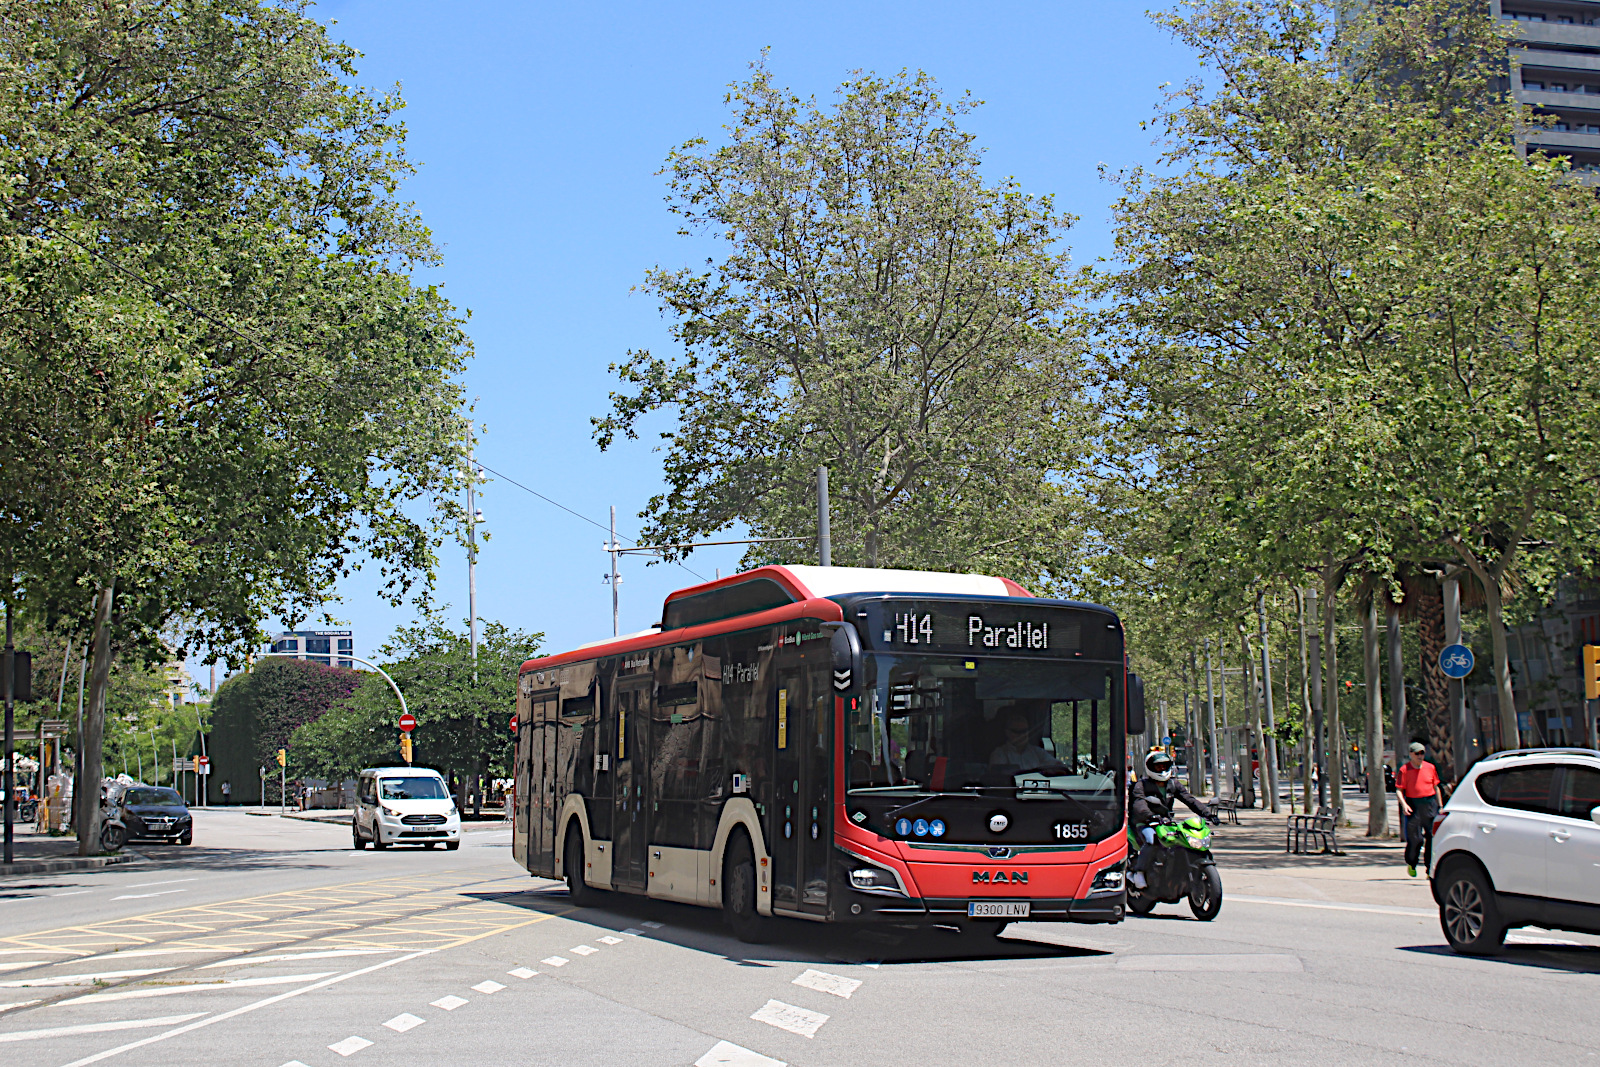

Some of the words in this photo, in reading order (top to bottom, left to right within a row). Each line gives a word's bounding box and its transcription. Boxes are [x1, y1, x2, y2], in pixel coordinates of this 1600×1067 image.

[895, 612, 933, 644] H14
[723, 664, 734, 685] H14
[1054, 823, 1089, 839] 1855
[972, 870, 1029, 883] MAN
[976, 904, 1004, 915] 9300
[1006, 904, 1027, 915] LNV
